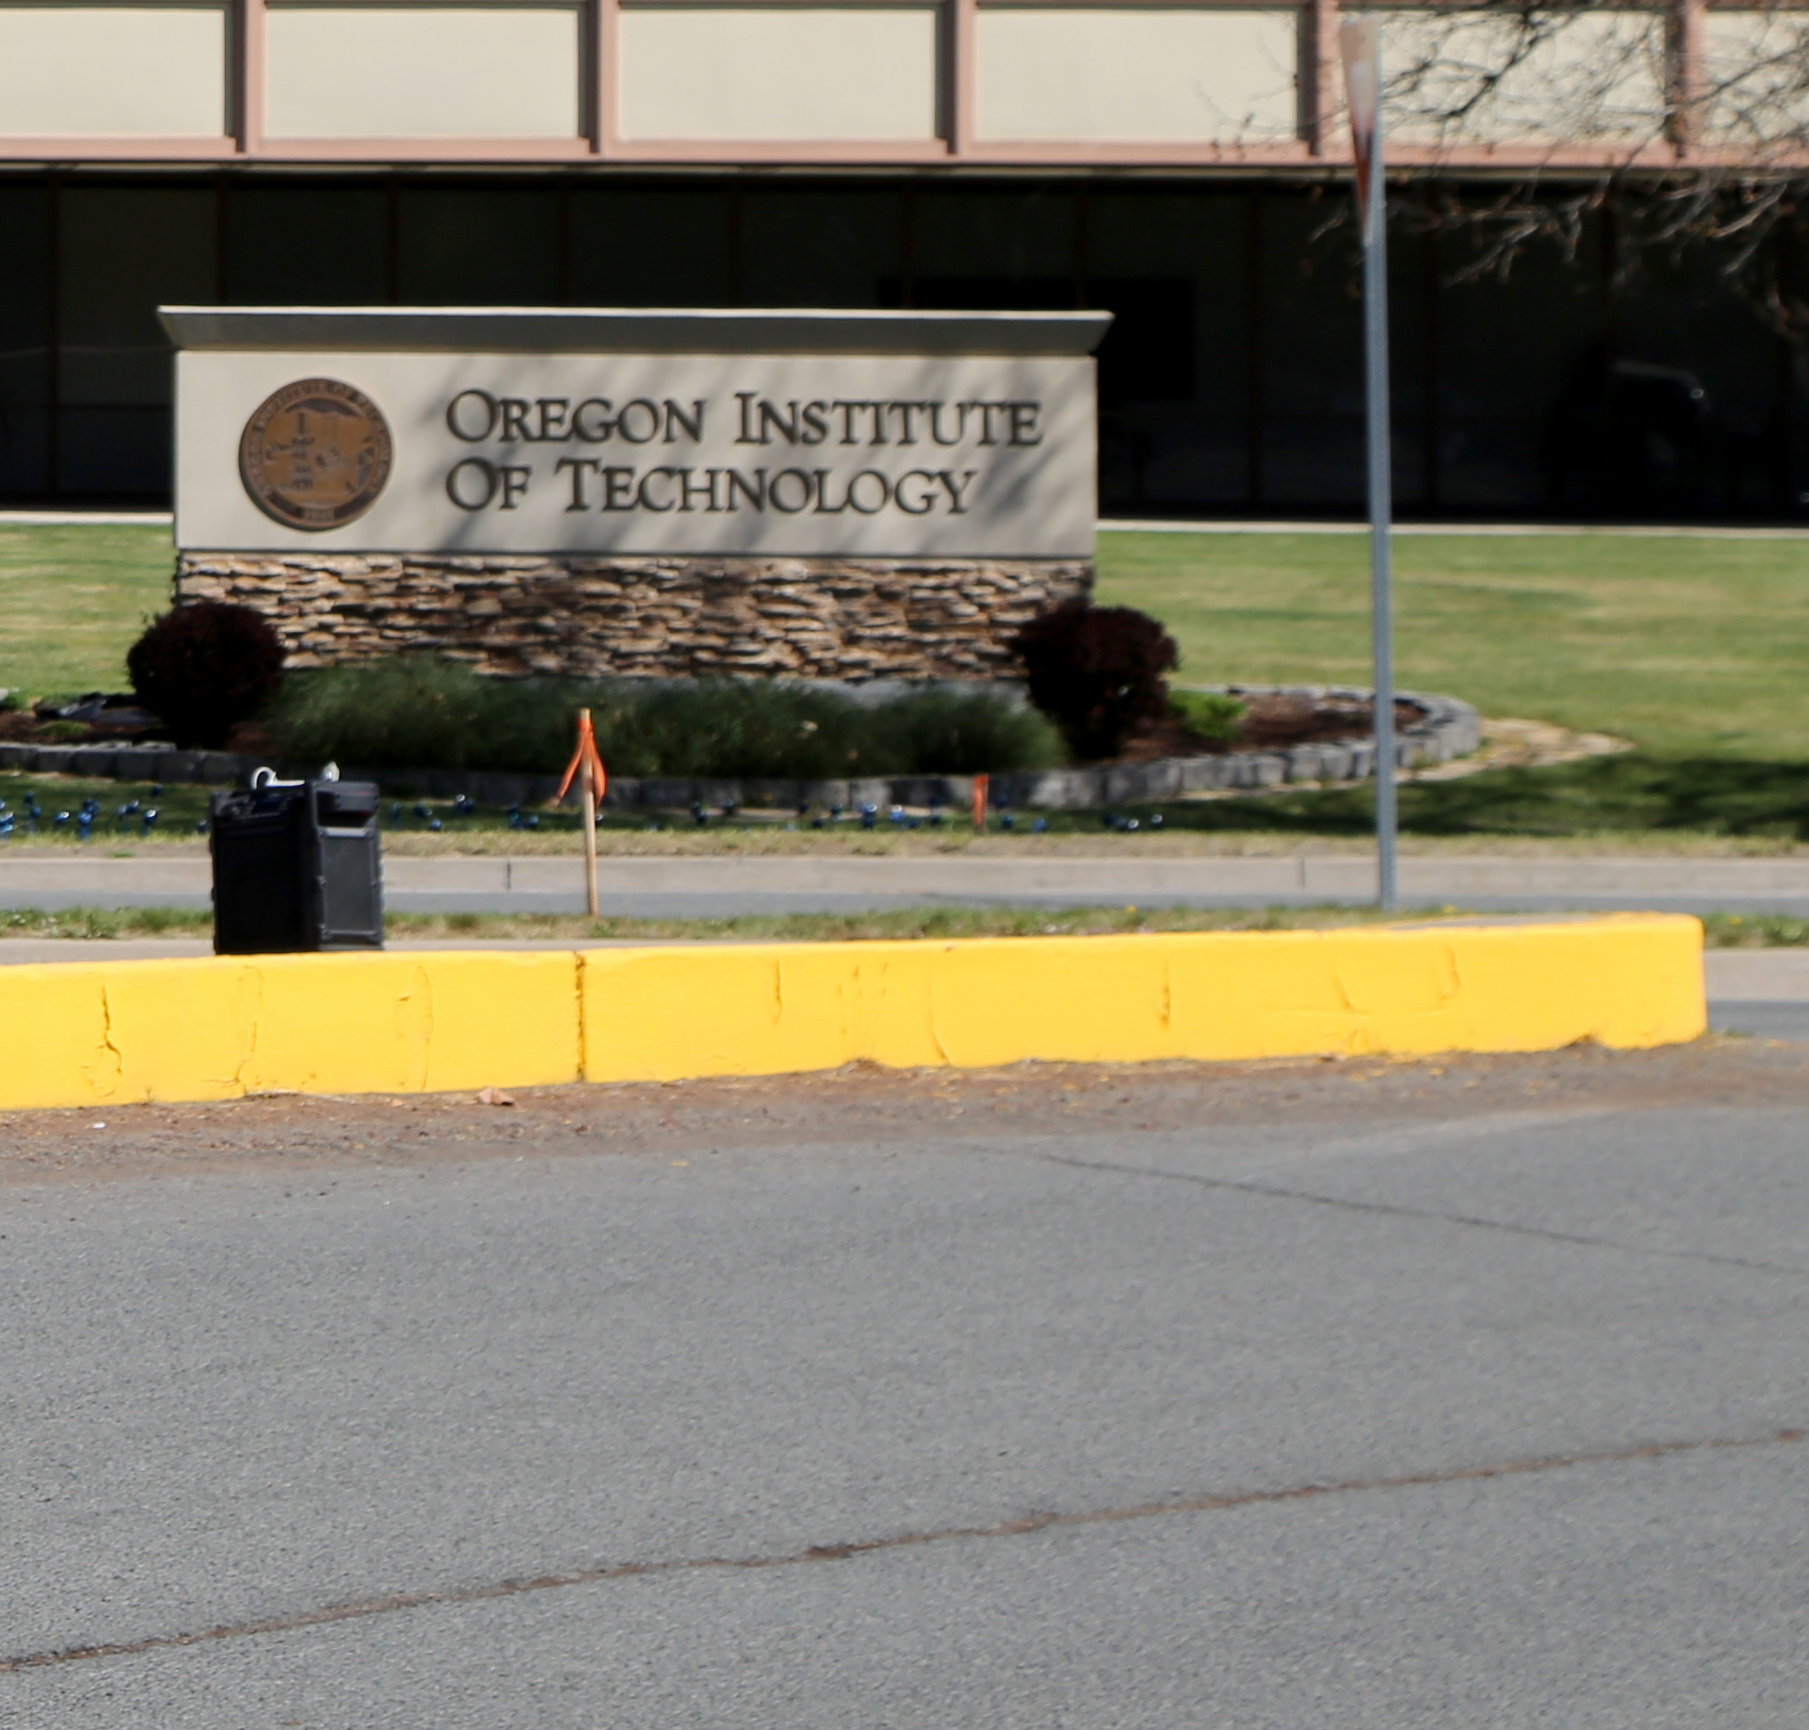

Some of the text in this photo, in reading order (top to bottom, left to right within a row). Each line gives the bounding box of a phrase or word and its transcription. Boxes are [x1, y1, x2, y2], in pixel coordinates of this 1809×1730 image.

[445, 388, 708, 447] OREGON
[734, 390, 1044, 448] INSTITUTE
[445, 456, 979, 516] OF TECHNOLOGY
